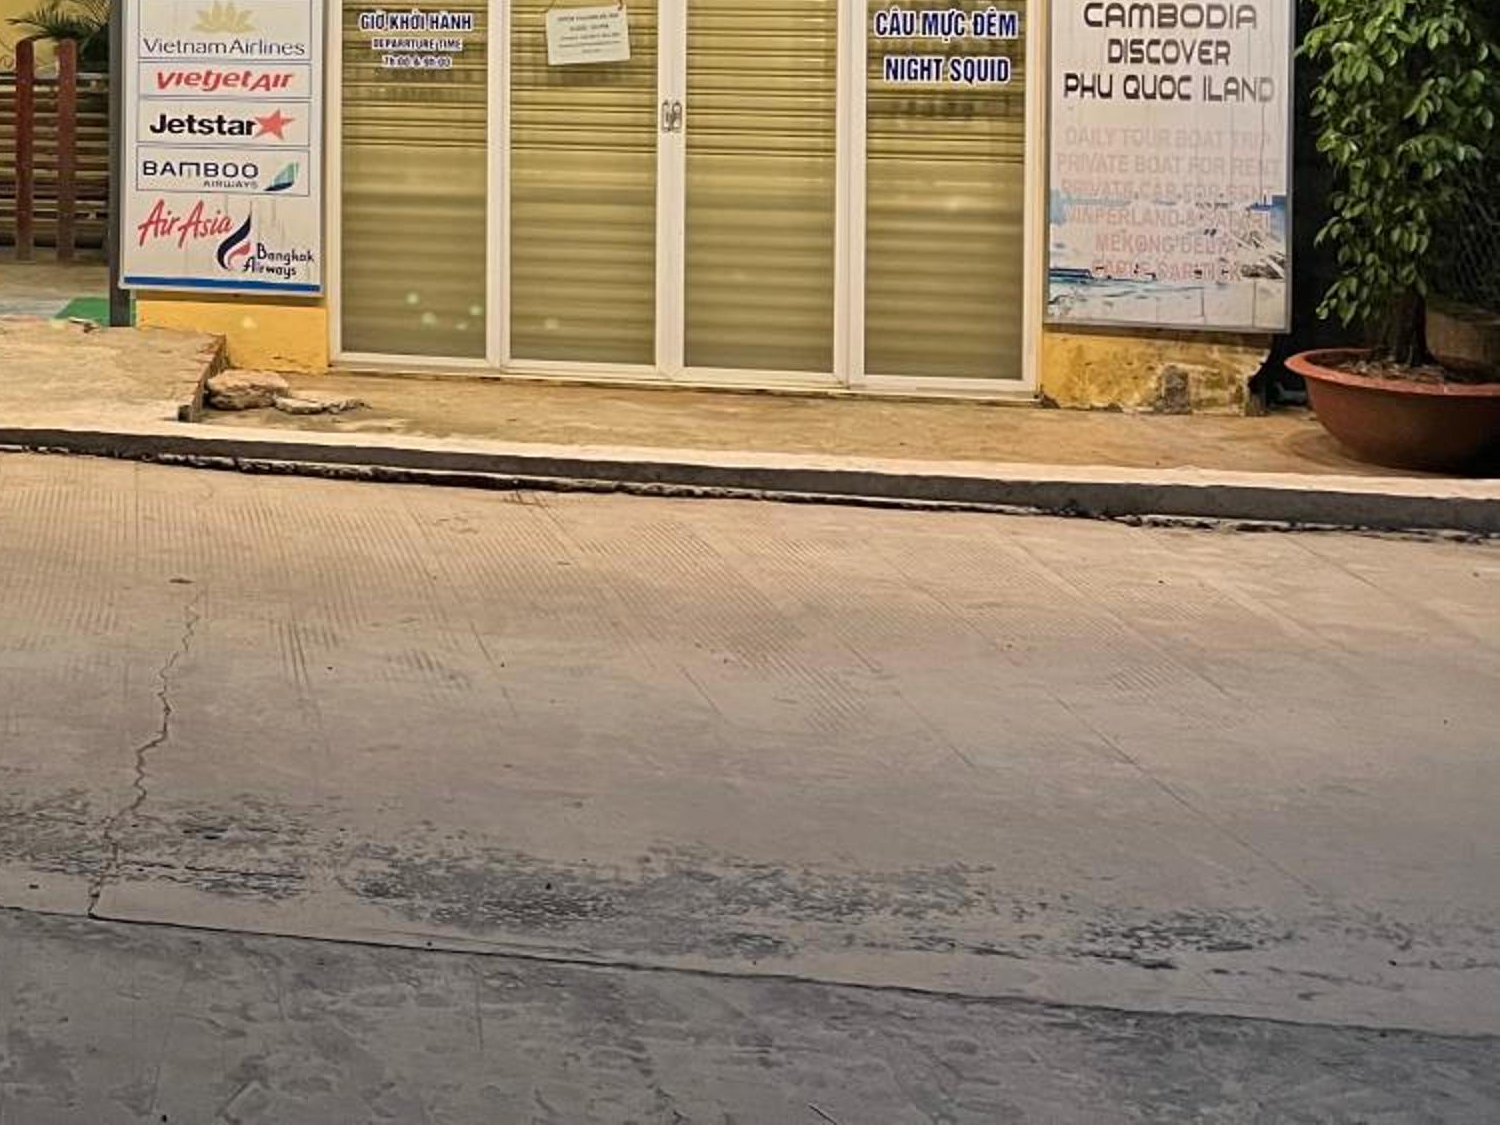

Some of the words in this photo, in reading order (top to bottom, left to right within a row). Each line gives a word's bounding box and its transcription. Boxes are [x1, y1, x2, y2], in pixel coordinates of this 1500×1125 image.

[875, 7, 914, 36] CÂU
[972, 7, 1017, 36] ĐÊM
[1083, 2, 1258, 30] CAMBODIA
[439, 38, 461, 50] TIME
[1108, 38, 1231, 66] DISCOVER
[885, 58, 943, 81] NIGHT
[950, 58, 1010, 84] SQUID
[1063, 73, 1113, 100] PHU
[1122, 74, 1192, 101] QUOC
[1202, 76, 1275, 103] ILAND
[150, 114, 256, 136] Jetstar
[143, 160, 260, 179] BAMBOO
[203, 180, 259, 189] AIRWAYS
[256, 243, 315, 265] Bangkok
[242, 256, 298, 279] Airways
